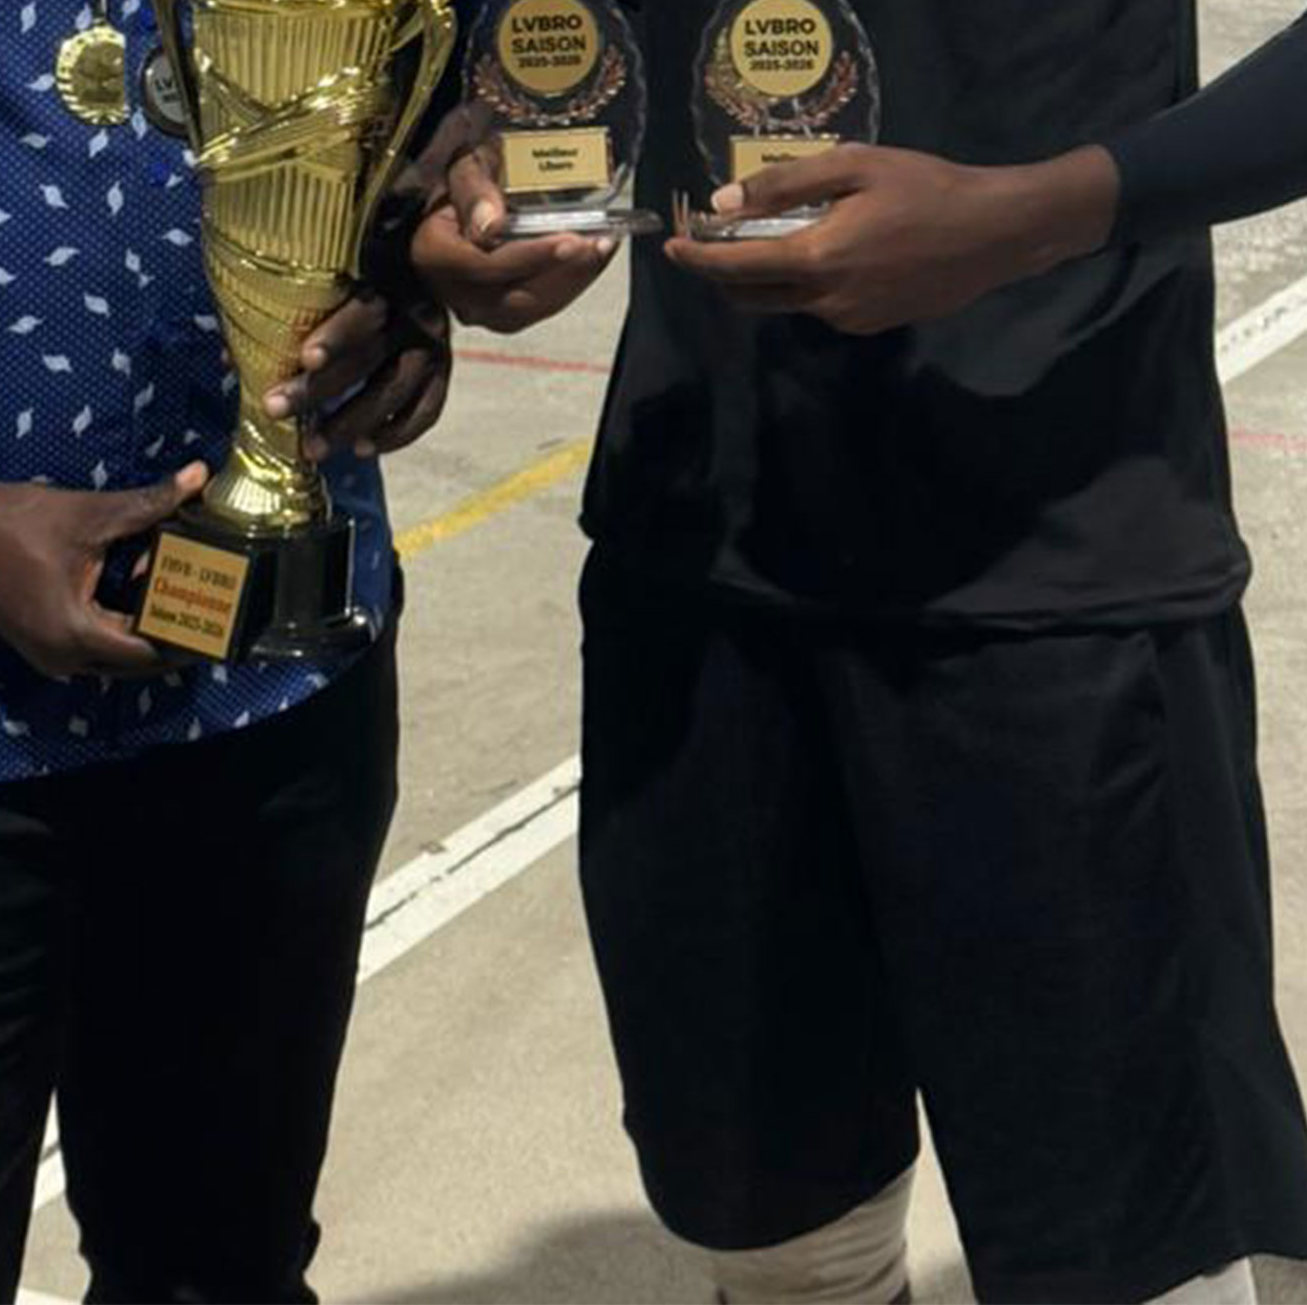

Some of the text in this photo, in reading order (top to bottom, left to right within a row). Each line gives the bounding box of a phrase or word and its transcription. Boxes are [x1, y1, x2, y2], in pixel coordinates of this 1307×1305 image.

[512, 14, 582, 33] LVBRO
[744, 18, 816, 36] LVBRO
[511, 35, 586, 55] SAISON
[744, 40, 819, 58] SAISON
